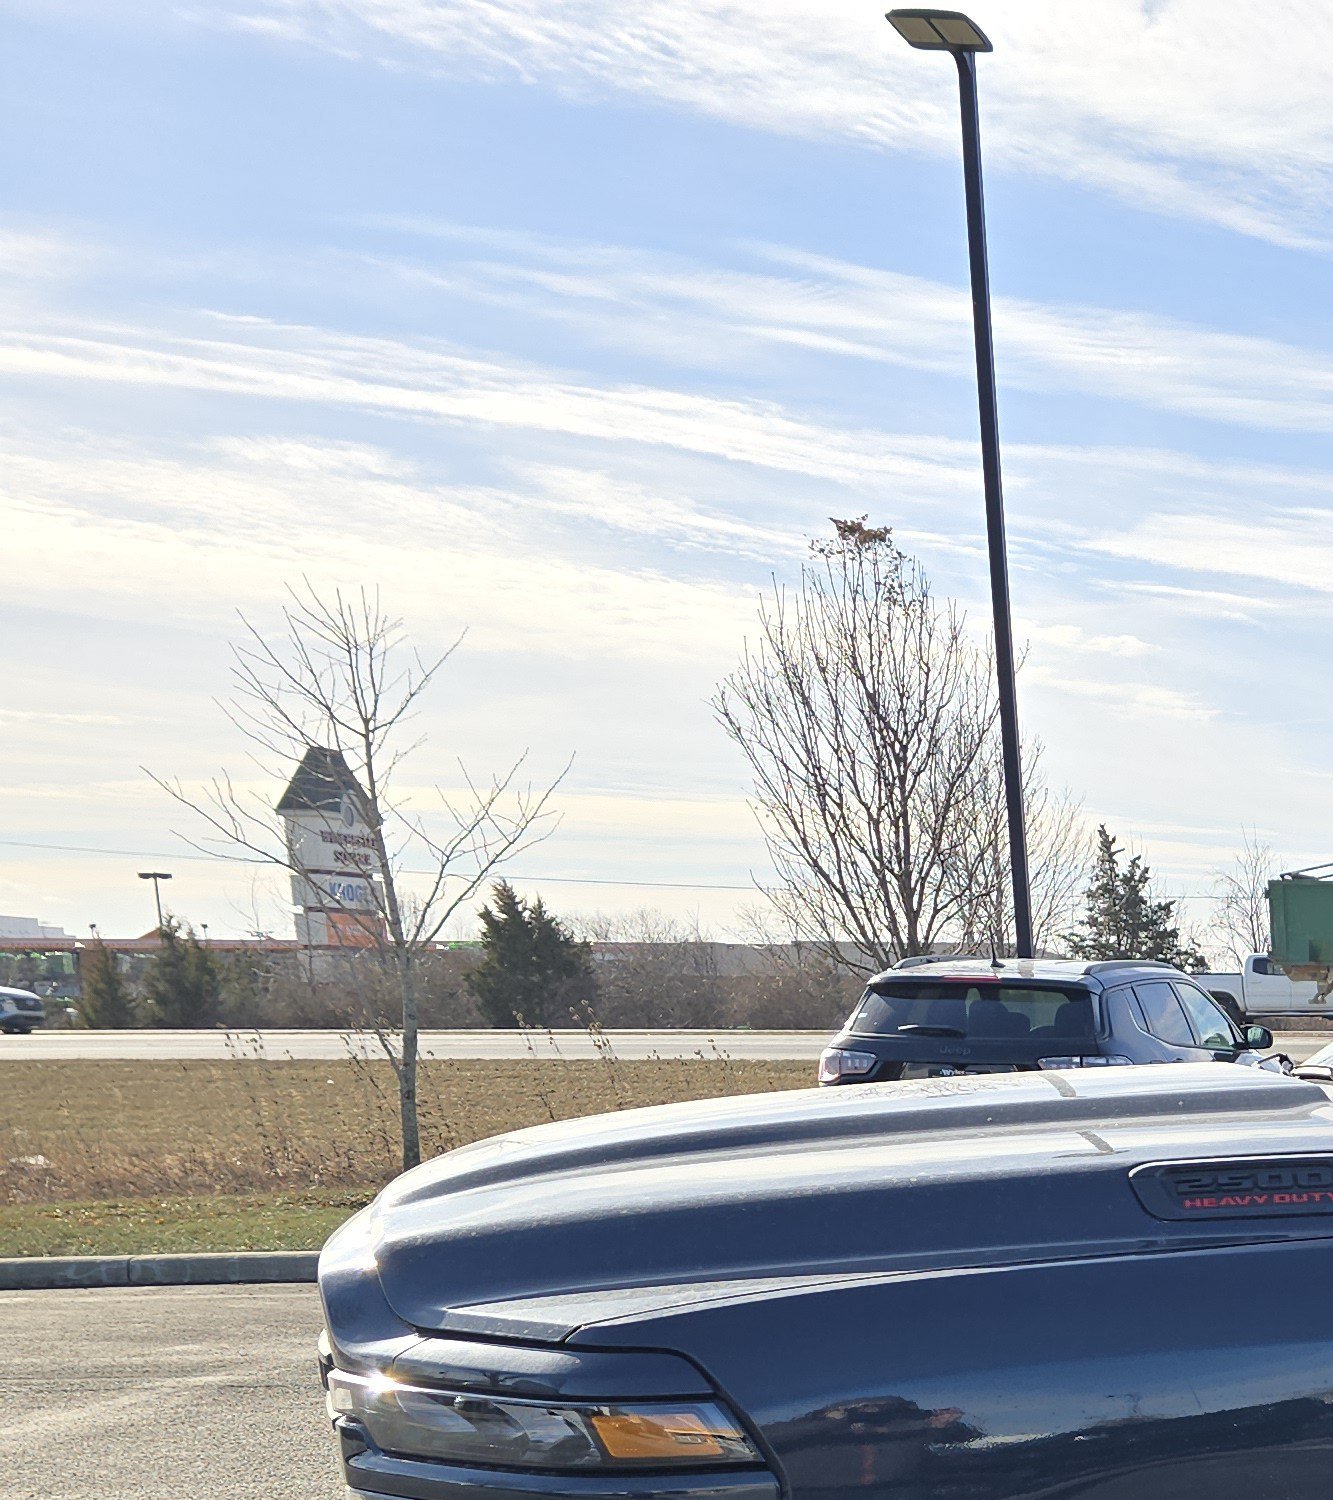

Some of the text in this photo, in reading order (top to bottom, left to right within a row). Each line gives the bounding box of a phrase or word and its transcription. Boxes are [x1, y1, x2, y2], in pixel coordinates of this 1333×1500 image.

[940, 1046, 971, 1056] Jeep
[1176, 1167, 1333, 1196] 2500
[1184, 1194, 1268, 1208] HEAVY
